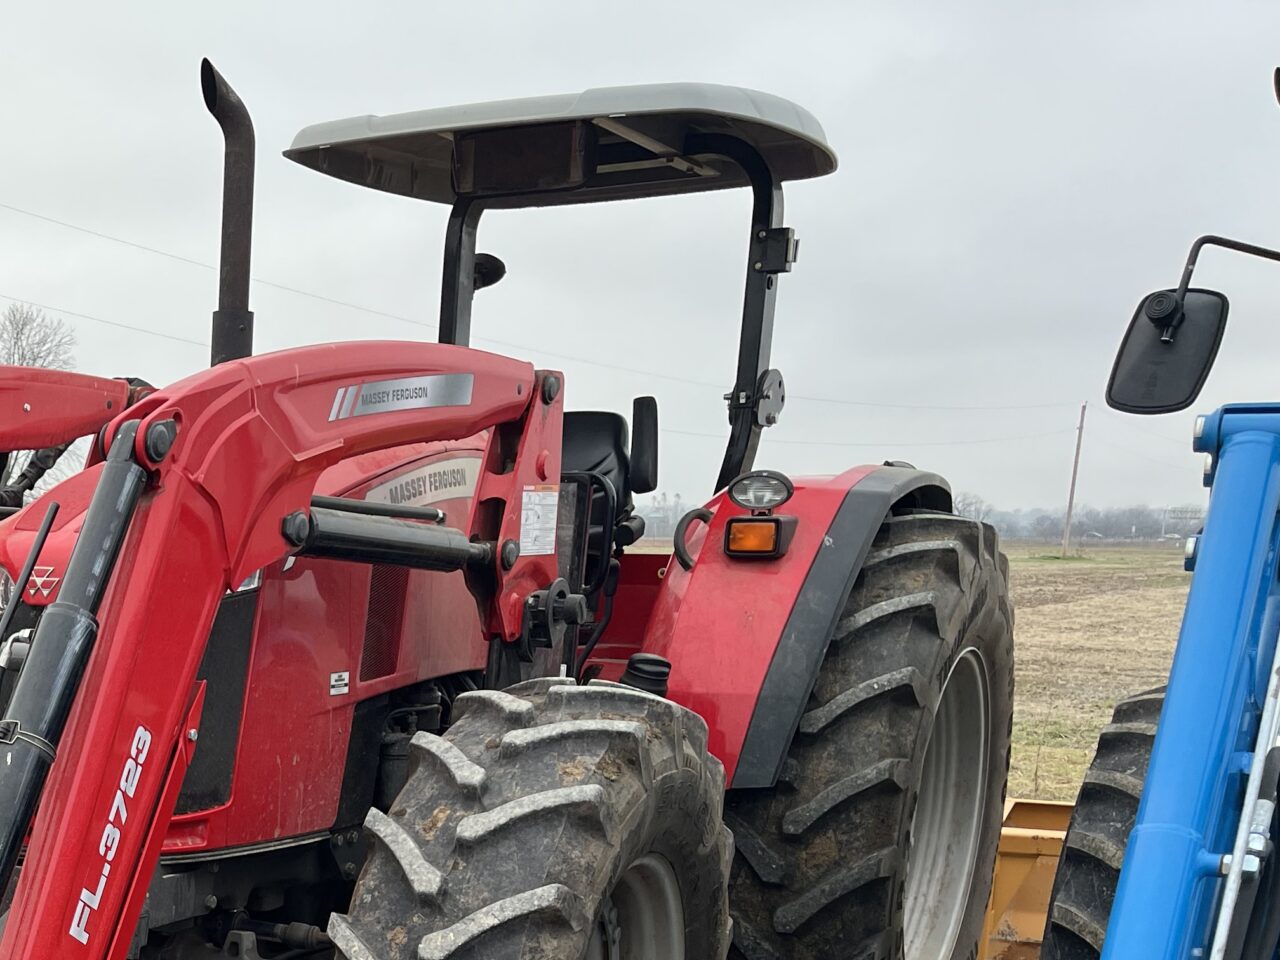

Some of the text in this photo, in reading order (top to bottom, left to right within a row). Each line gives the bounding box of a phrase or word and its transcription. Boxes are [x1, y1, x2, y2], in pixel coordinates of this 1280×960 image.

[361, 386, 428, 406] MASSEY FERGUSON
[389, 468, 467, 504] MASSEY FERGUSON
[69, 725, 152, 945] FL.3723
